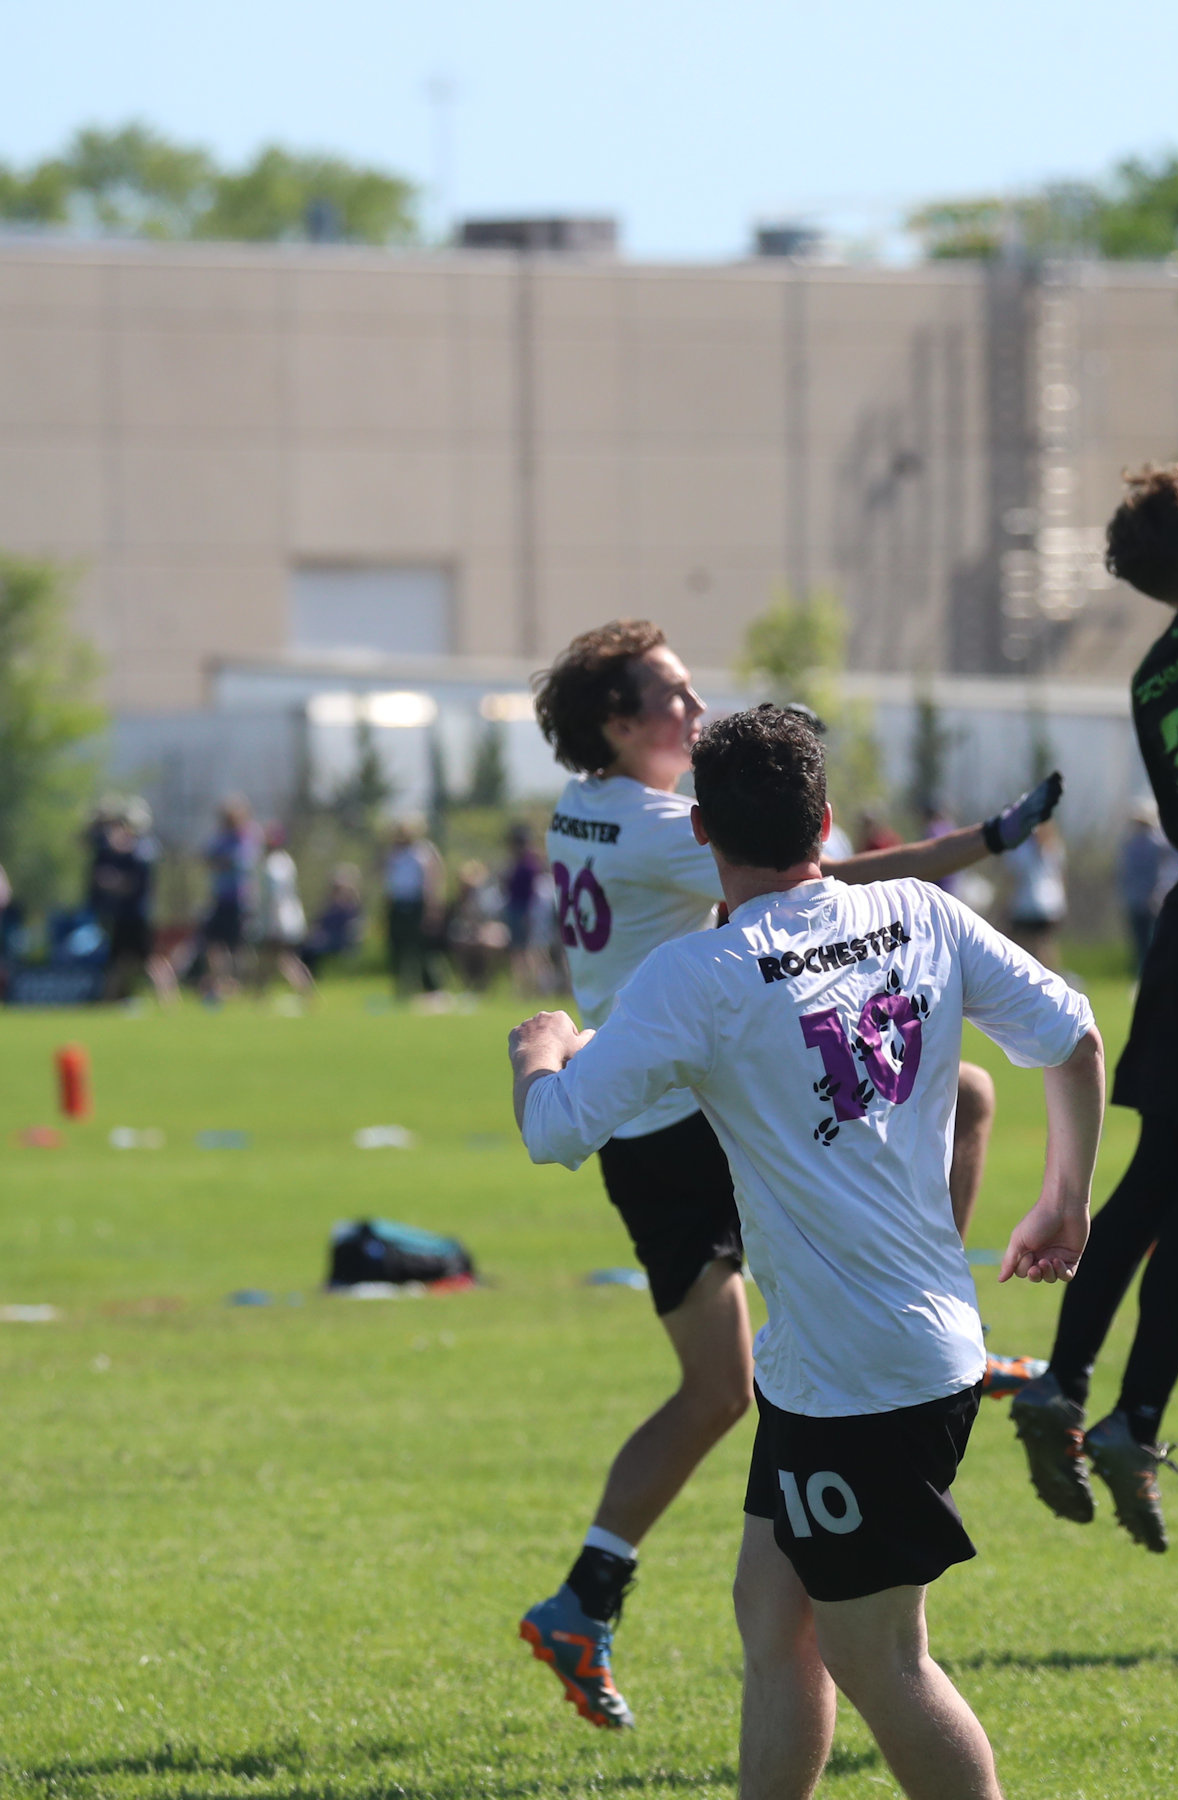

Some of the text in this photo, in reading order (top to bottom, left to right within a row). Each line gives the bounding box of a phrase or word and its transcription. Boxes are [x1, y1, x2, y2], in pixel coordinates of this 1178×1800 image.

[758, 921, 911, 984] ROCHESTER
[800, 993, 923, 1122] 10
[778, 1469, 863, 1538] 10
